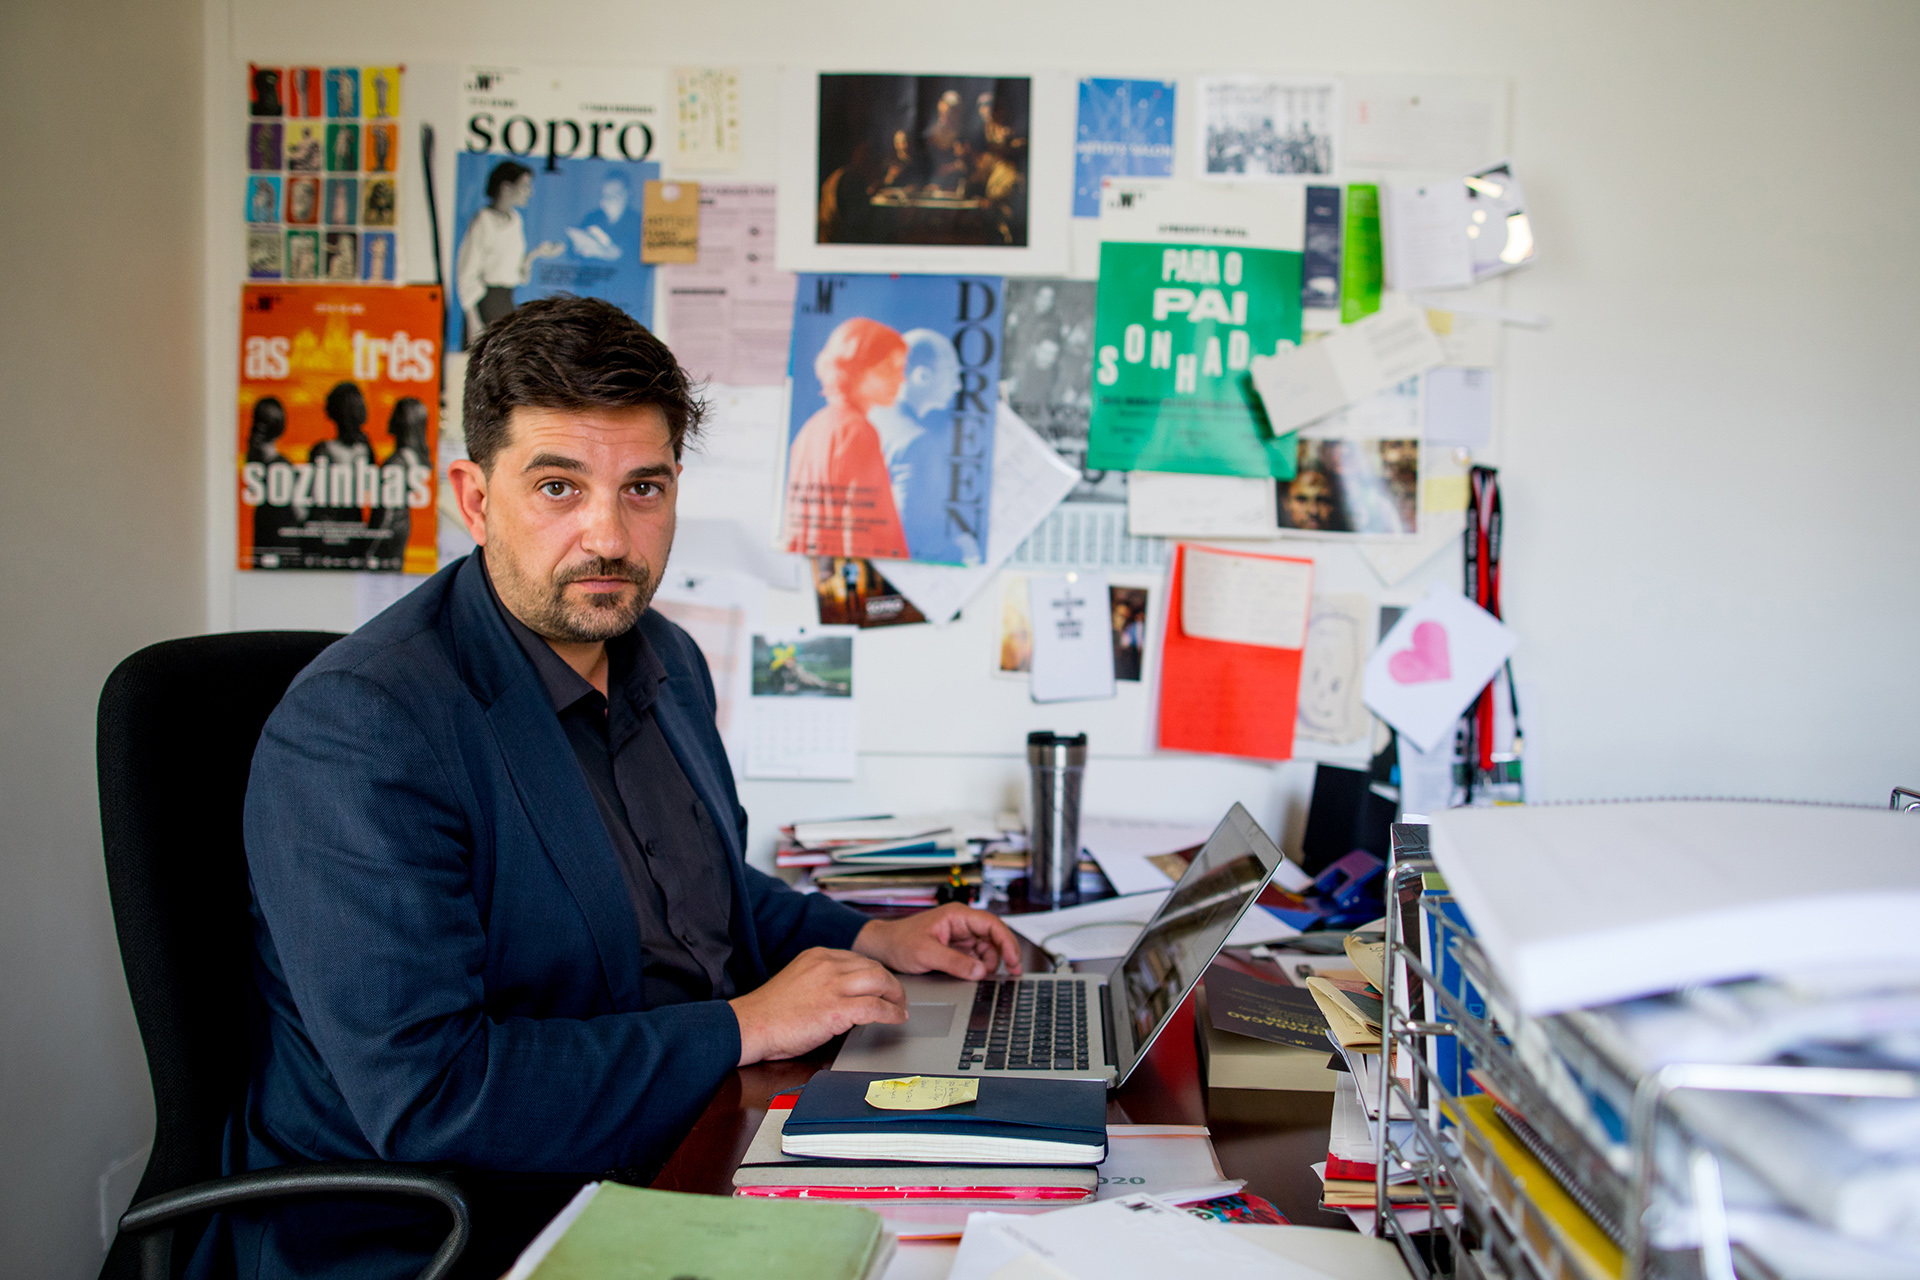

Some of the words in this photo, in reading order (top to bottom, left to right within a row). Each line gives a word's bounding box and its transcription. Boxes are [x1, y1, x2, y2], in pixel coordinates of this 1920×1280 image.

[466, 112, 654, 173] sopro
[1163, 249, 1220, 285] PARA
[1224, 252, 1243, 286] O
[1153, 287, 1248, 325] PAI
[245, 336, 290, 379] as
[352, 330, 434, 381] três
[1097, 324, 1296, 393] SONHAD
[945, 281, 996, 540] DOREEN
[242, 455, 431, 509] sozinhas
[1227, 1011, 1326, 1036] REPARAÇÃO
[1098, 1176, 1145, 1185] 020
